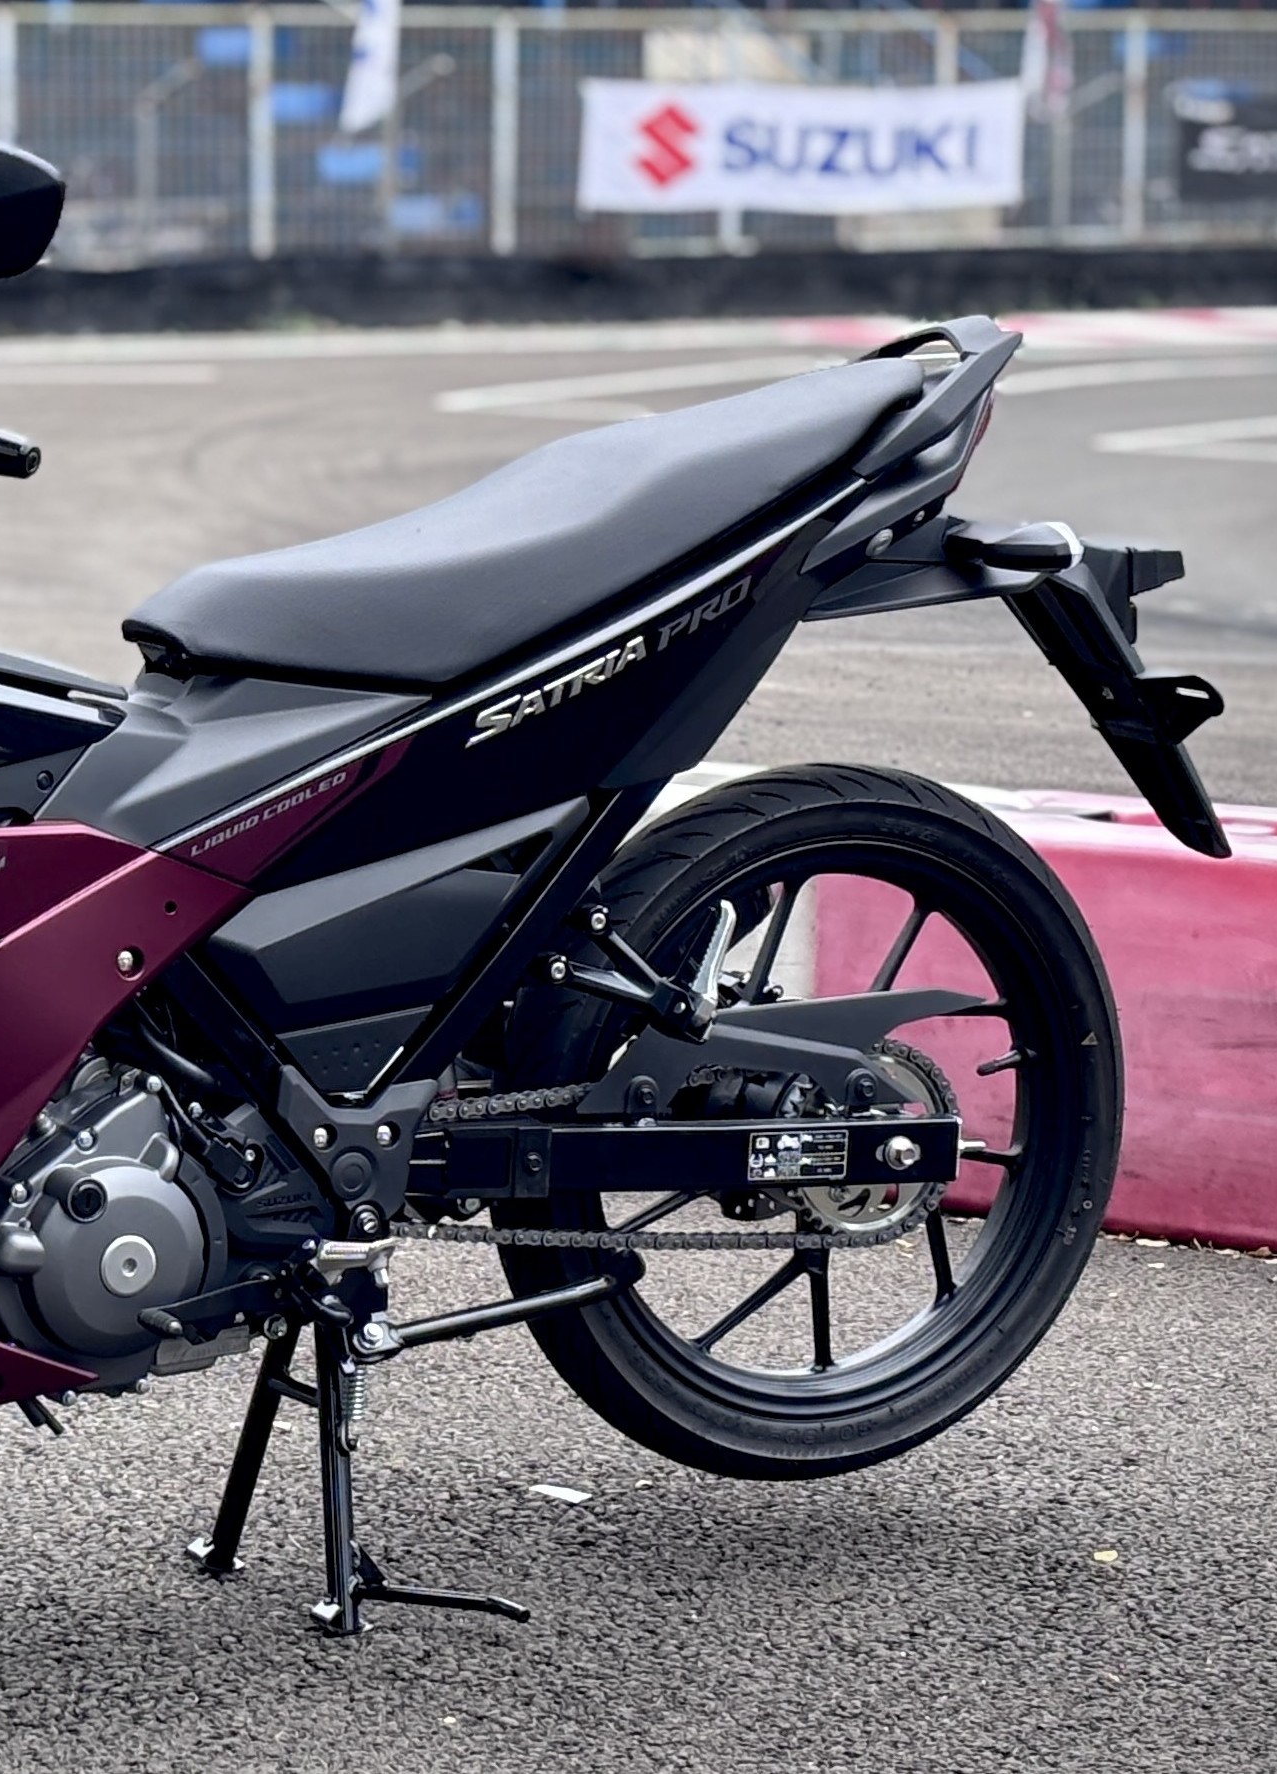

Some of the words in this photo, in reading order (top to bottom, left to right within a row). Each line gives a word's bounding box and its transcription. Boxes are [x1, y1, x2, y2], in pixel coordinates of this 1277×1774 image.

[722, 117, 979, 177] SUZUKI
[465, 635, 647, 749] SATRIA
[657, 574, 752, 652] PRO
[190, 814, 260, 858] LIQUID
[263, 771, 347, 821] COOLED
[256, 1192, 311, 1208] SUZUKI
